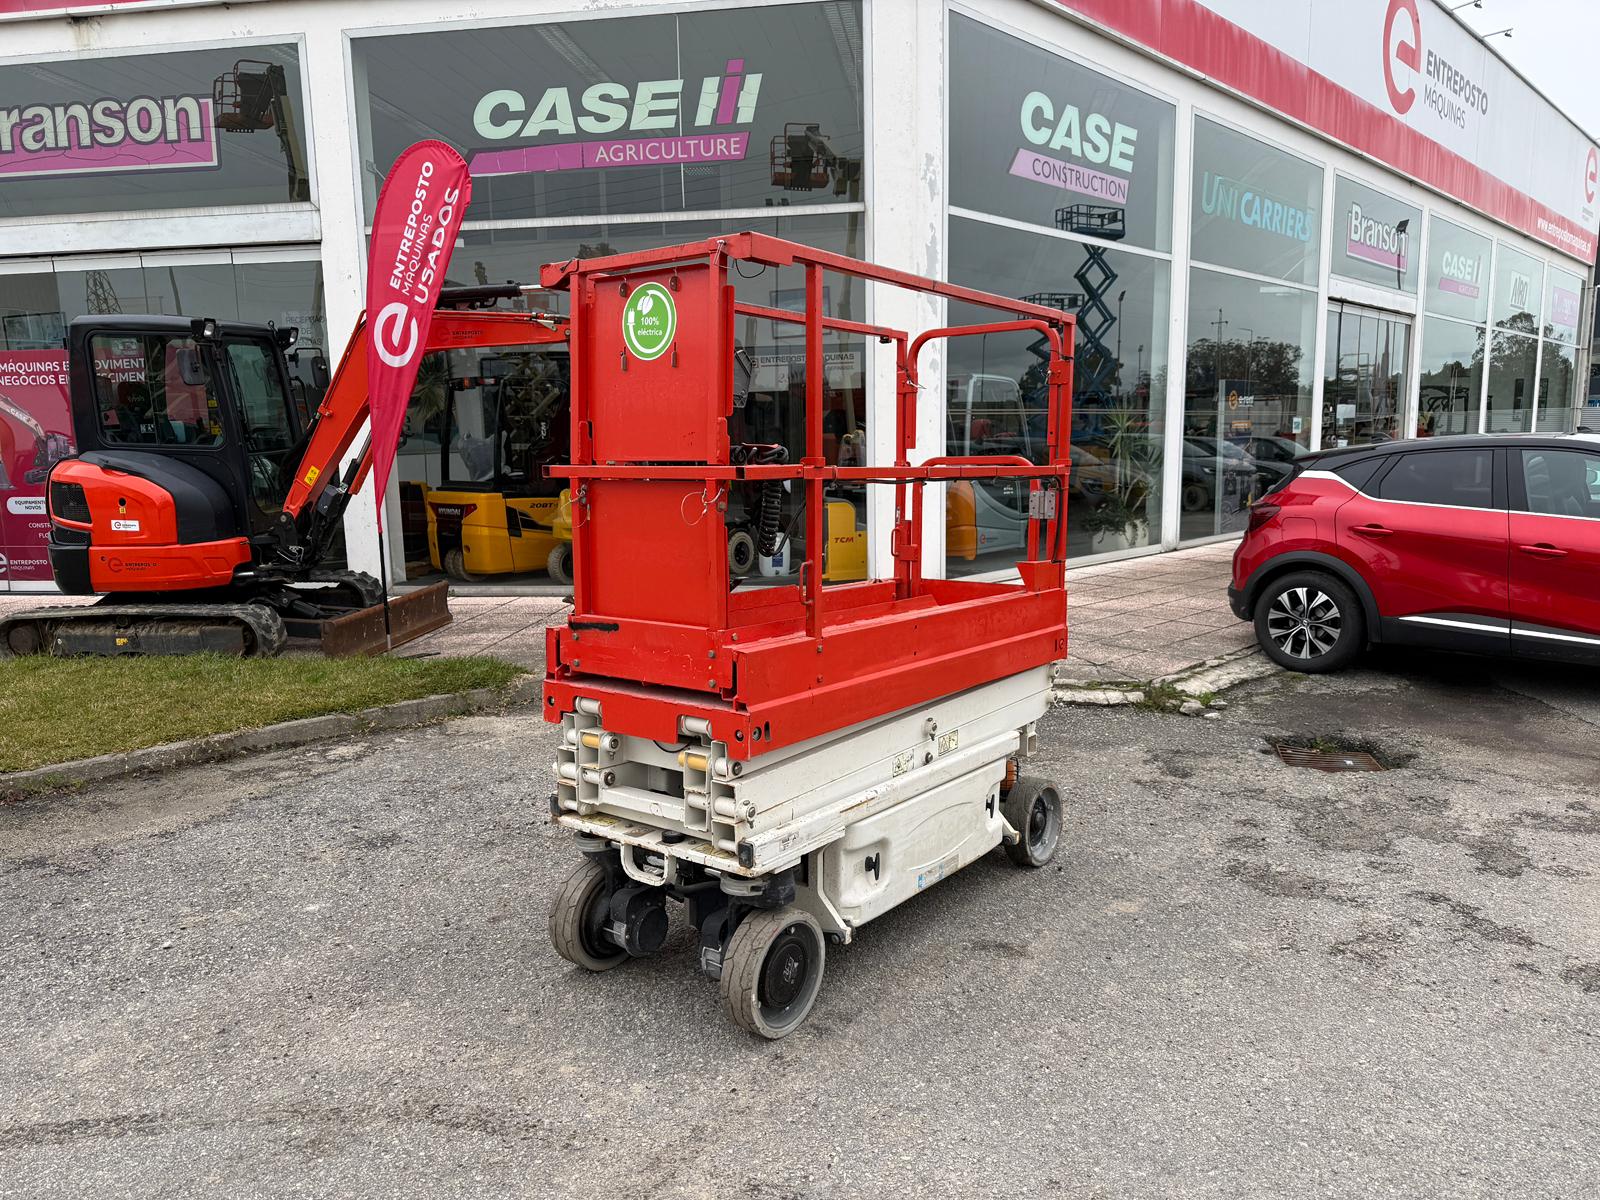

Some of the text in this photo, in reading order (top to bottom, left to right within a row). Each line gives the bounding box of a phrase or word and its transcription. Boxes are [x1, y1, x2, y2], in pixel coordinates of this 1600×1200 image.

[1424, 82, 1466, 129] MÁQUINAS
[1426, 49, 1488, 116] ENTREPOSTO
[0, 96, 201, 151] ranson
[473, 79, 684, 140] CASE
[1020, 91, 1138, 173] CASE
[595, 137, 741, 163] AGRICULTURE
[1032, 158, 1126, 200] CONSTRUCTION
[389, 161, 434, 290] ENTREPOSTO
[414, 187, 459, 304] USADOS
[402, 214, 433, 296] MÁQUINAS
[1443, 251, 1473, 280] CASE
[641, 317, 659, 326] 100%
[0, 359, 60, 374] MÁQUINAS
[95, 358, 145, 370] OVIMENT
[59, 374, 68, 384] E
[760, 354, 806, 364] ENTREPOST
[824, 351, 854, 361] QUINAS
